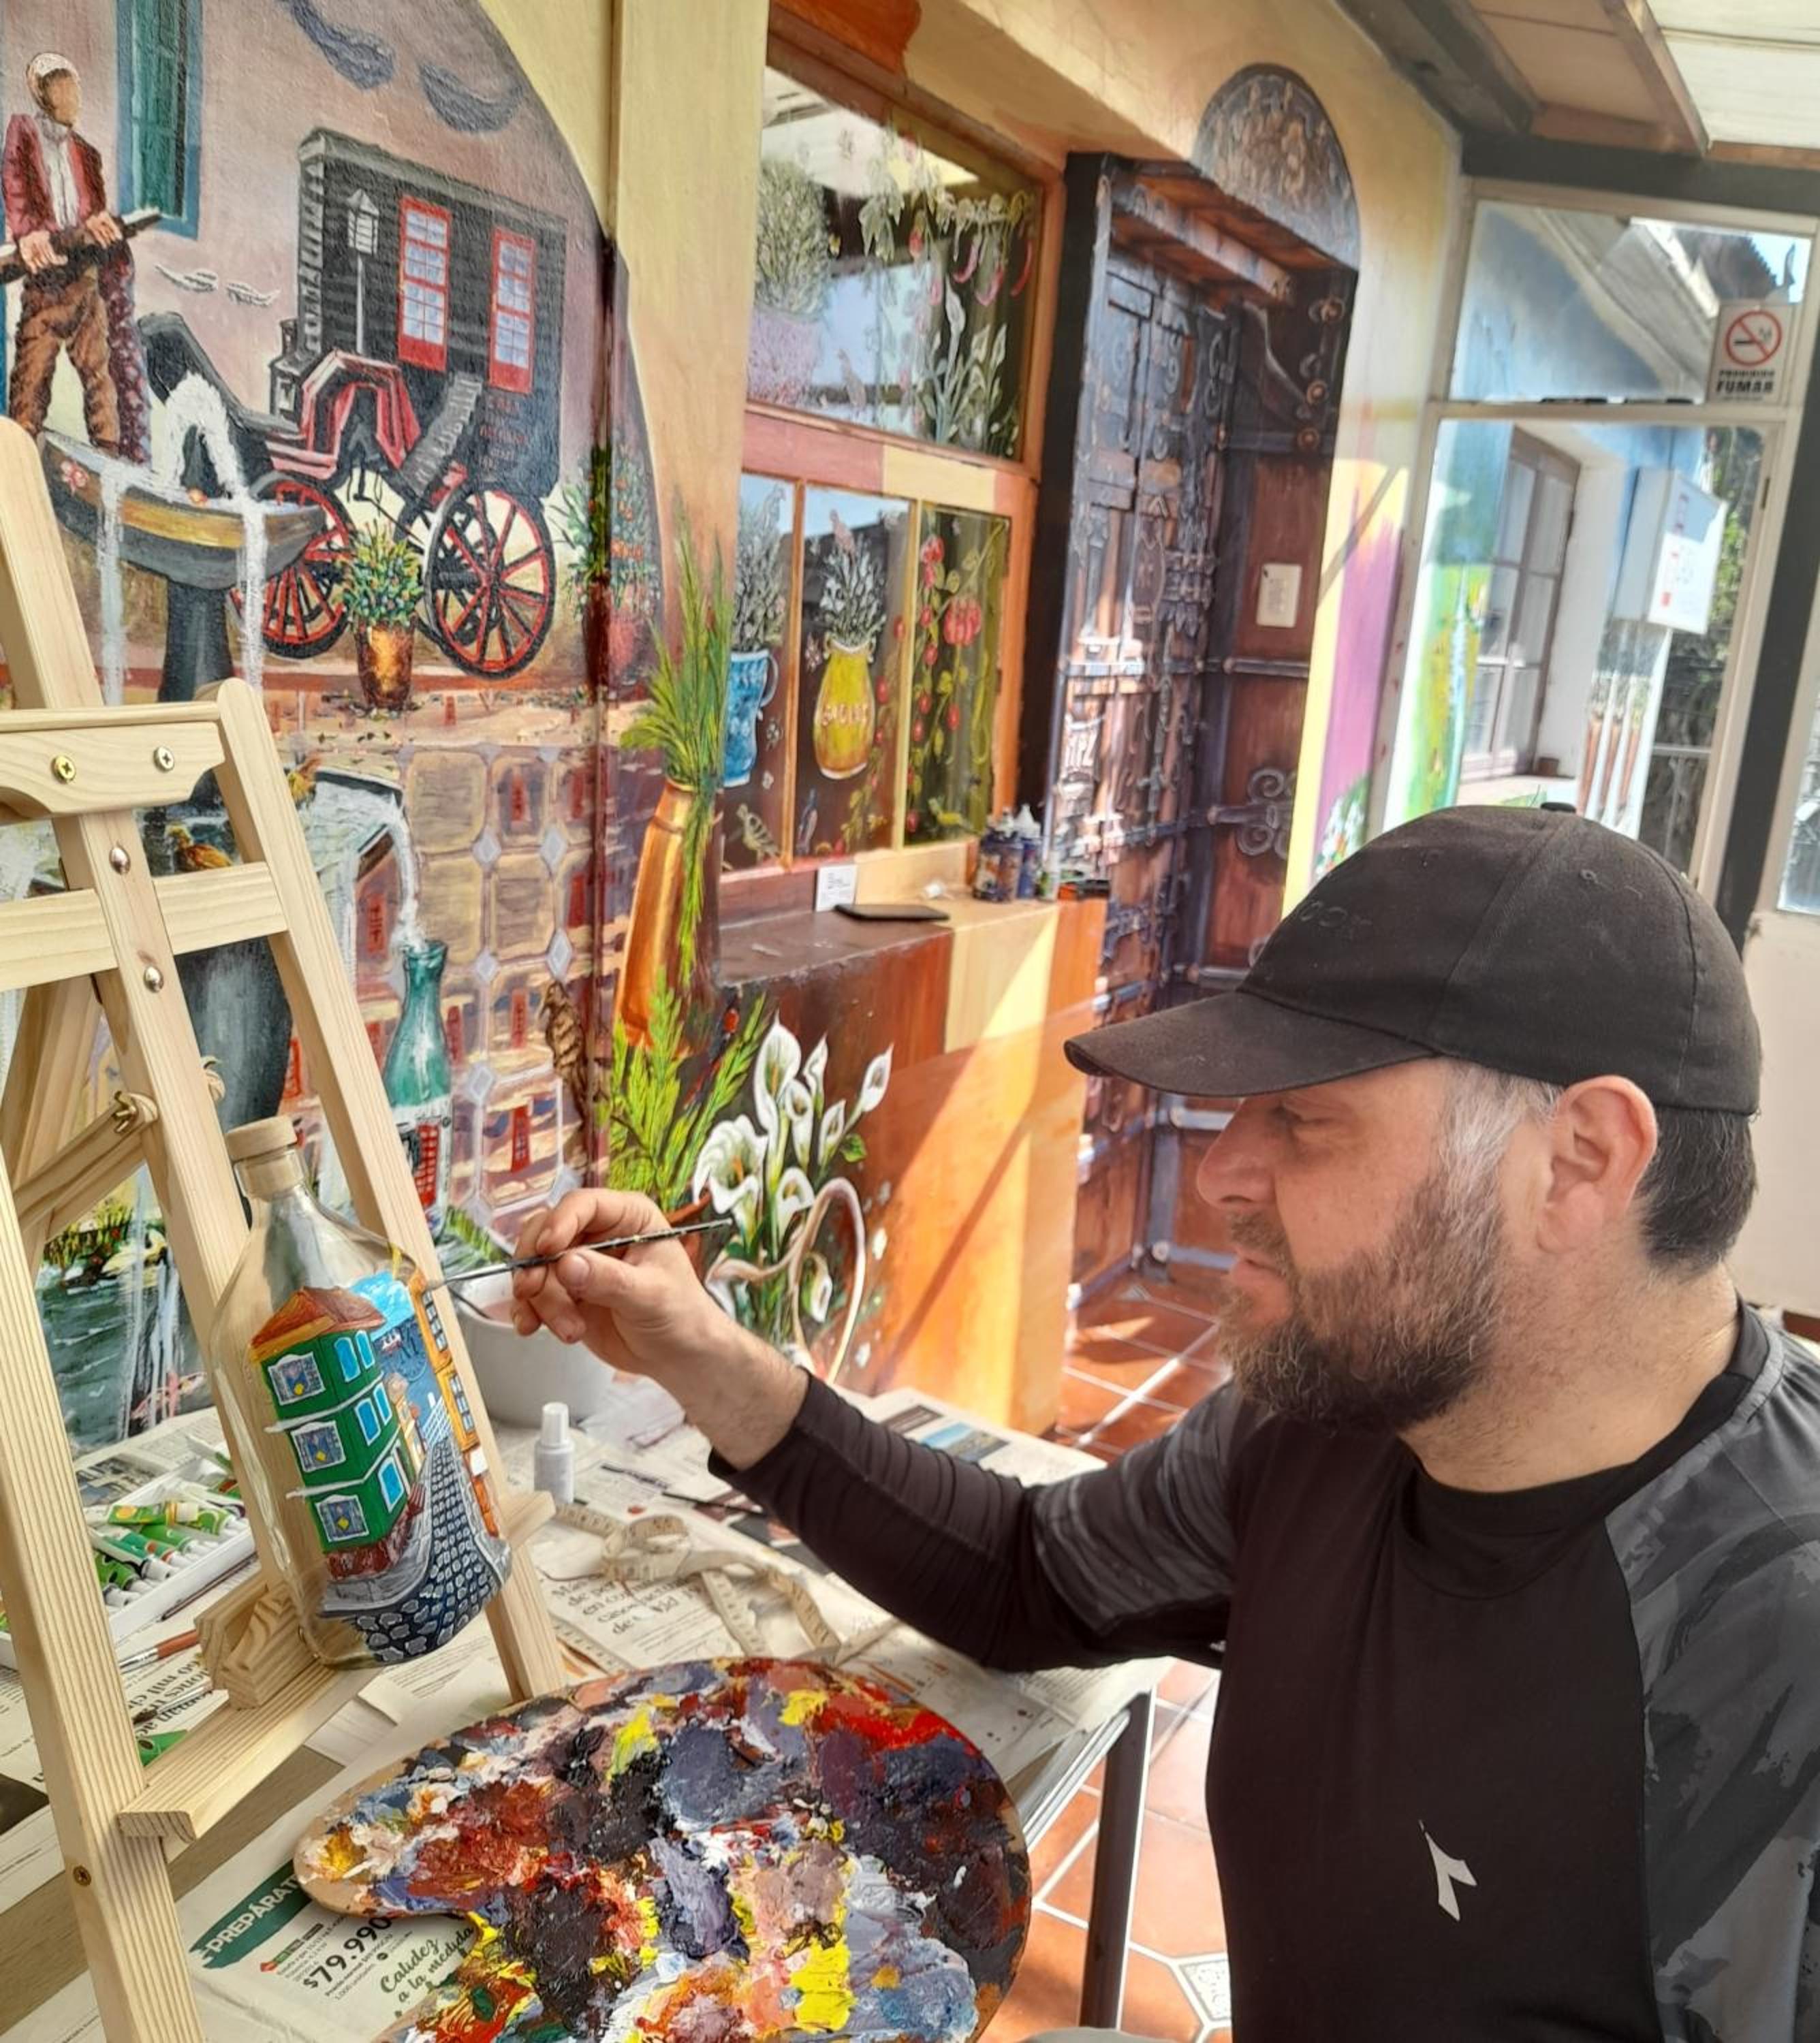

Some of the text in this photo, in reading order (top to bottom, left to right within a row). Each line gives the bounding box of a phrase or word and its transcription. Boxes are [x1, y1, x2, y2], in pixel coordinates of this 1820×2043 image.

[1716, 381, 1774, 393] FUMAR
[205, 1873, 300, 1953] PREPÁRAT
[302, 1916, 393, 1989] $79.990
[380, 1938, 439, 1993] Calidez
[398, 1991, 410, 2003] a
[407, 1974, 426, 1990] la
[428, 1927, 474, 1974] medida
